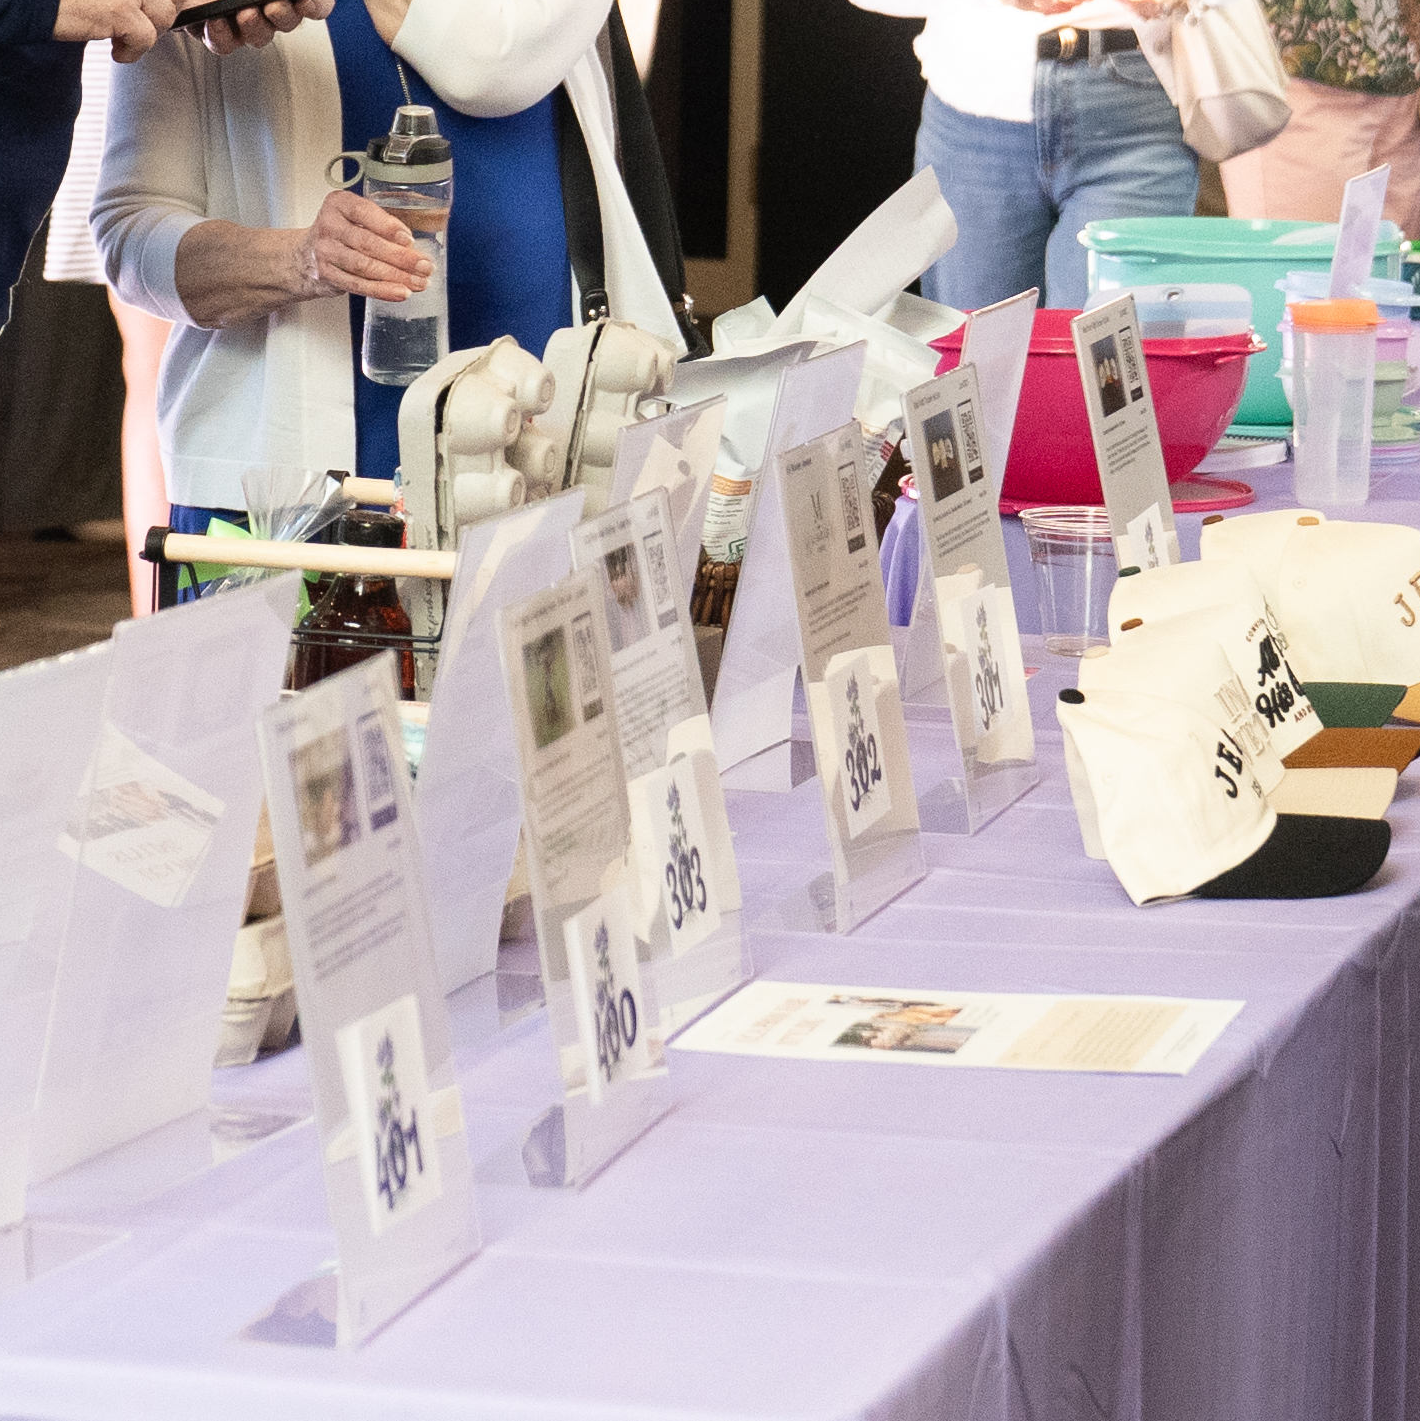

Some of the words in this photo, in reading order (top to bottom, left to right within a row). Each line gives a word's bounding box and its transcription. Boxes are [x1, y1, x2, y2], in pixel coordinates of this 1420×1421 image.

[975, 661, 1004, 732] 301
[845, 732, 882, 812] 302
[665, 844, 707, 931] 303
[594, 987, 637, 1083] 400
[375, 1106, 424, 1212] 401
